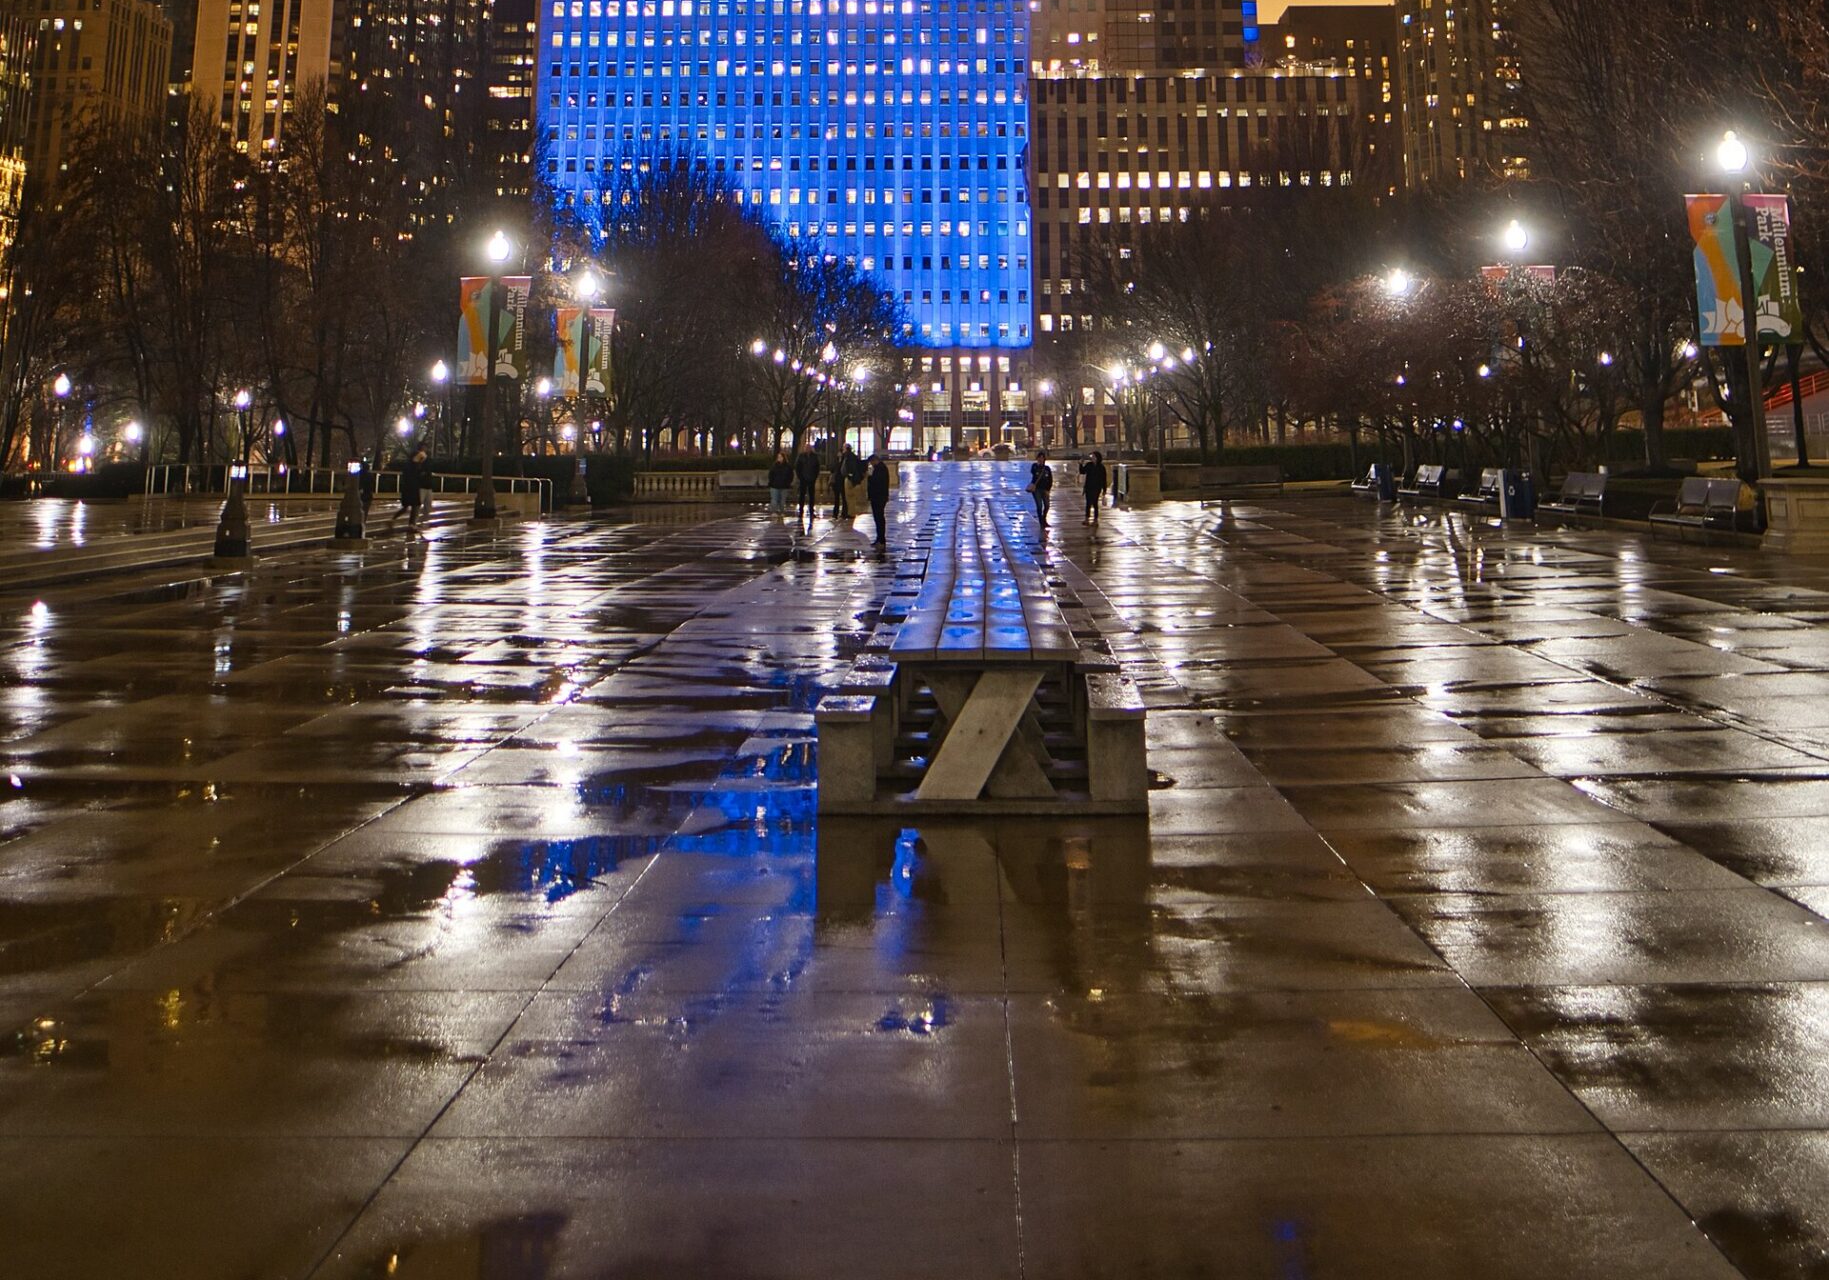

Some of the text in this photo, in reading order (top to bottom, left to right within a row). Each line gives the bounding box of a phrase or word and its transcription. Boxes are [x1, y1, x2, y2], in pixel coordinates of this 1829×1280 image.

[1756, 206, 1773, 241] Park
[1770, 207, 1790, 297] Millennium
[507, 286, 518, 311] Park
[515, 286, 528, 351] Millennium
[594, 317, 604, 337] Park
